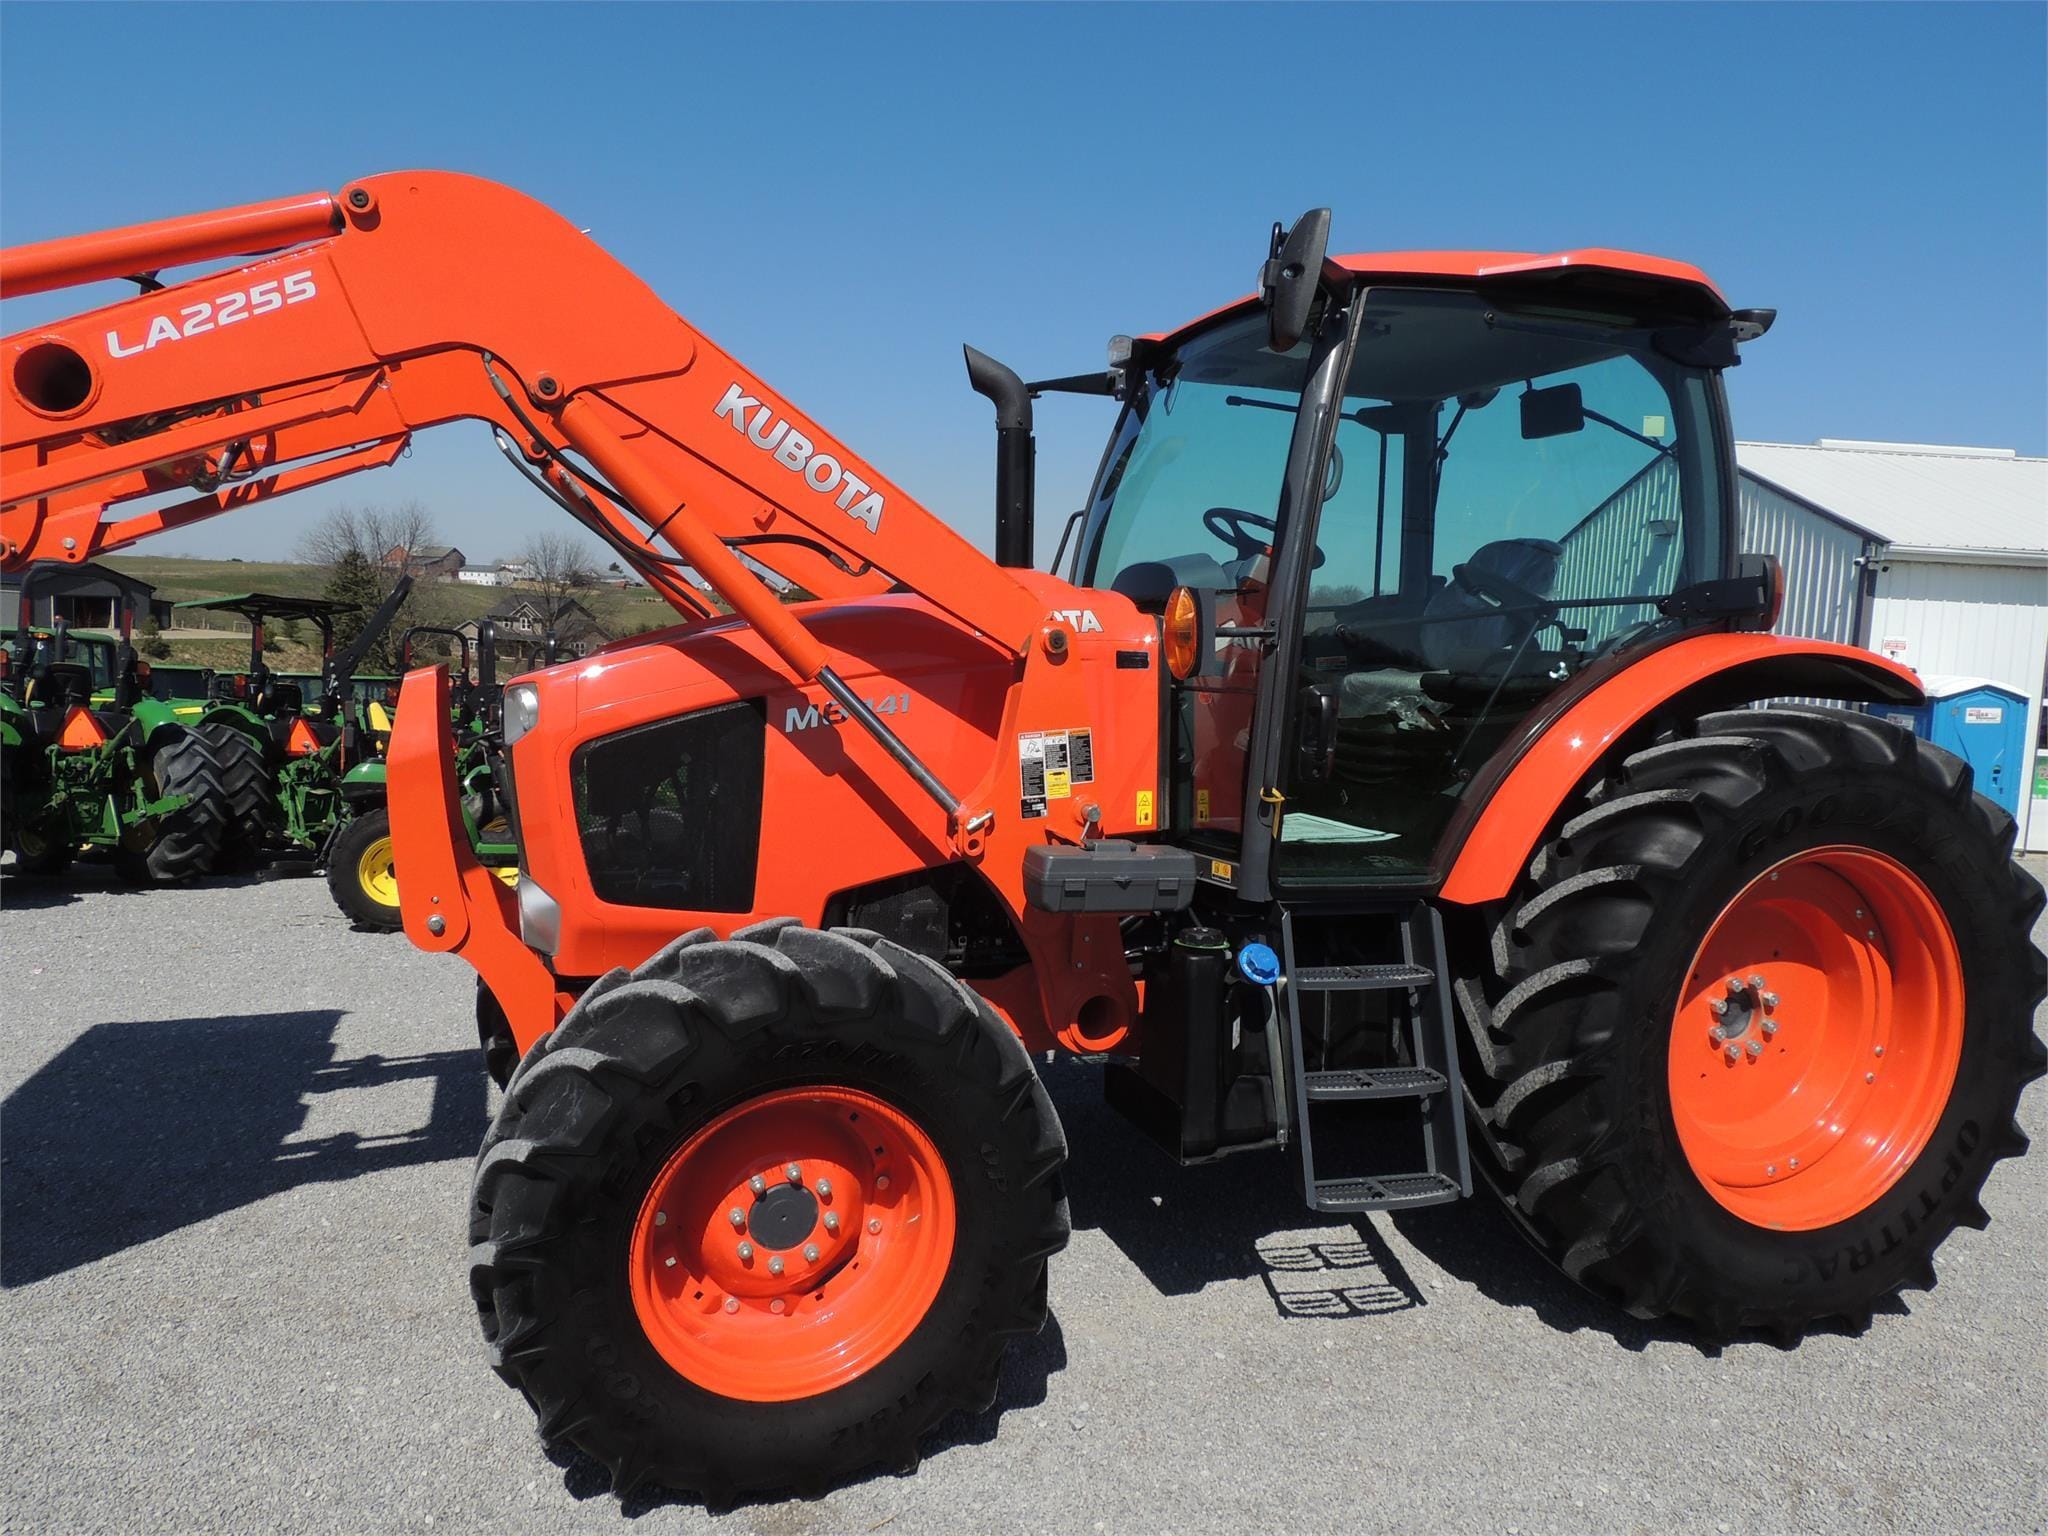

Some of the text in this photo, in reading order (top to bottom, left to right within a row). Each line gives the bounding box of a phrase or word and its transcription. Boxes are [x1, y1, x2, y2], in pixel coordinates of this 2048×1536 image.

[106, 269, 317, 359] LA2255
[713, 381, 885, 534] KUBOTA
[1780, 1118, 1981, 1286] OPTITRAC
